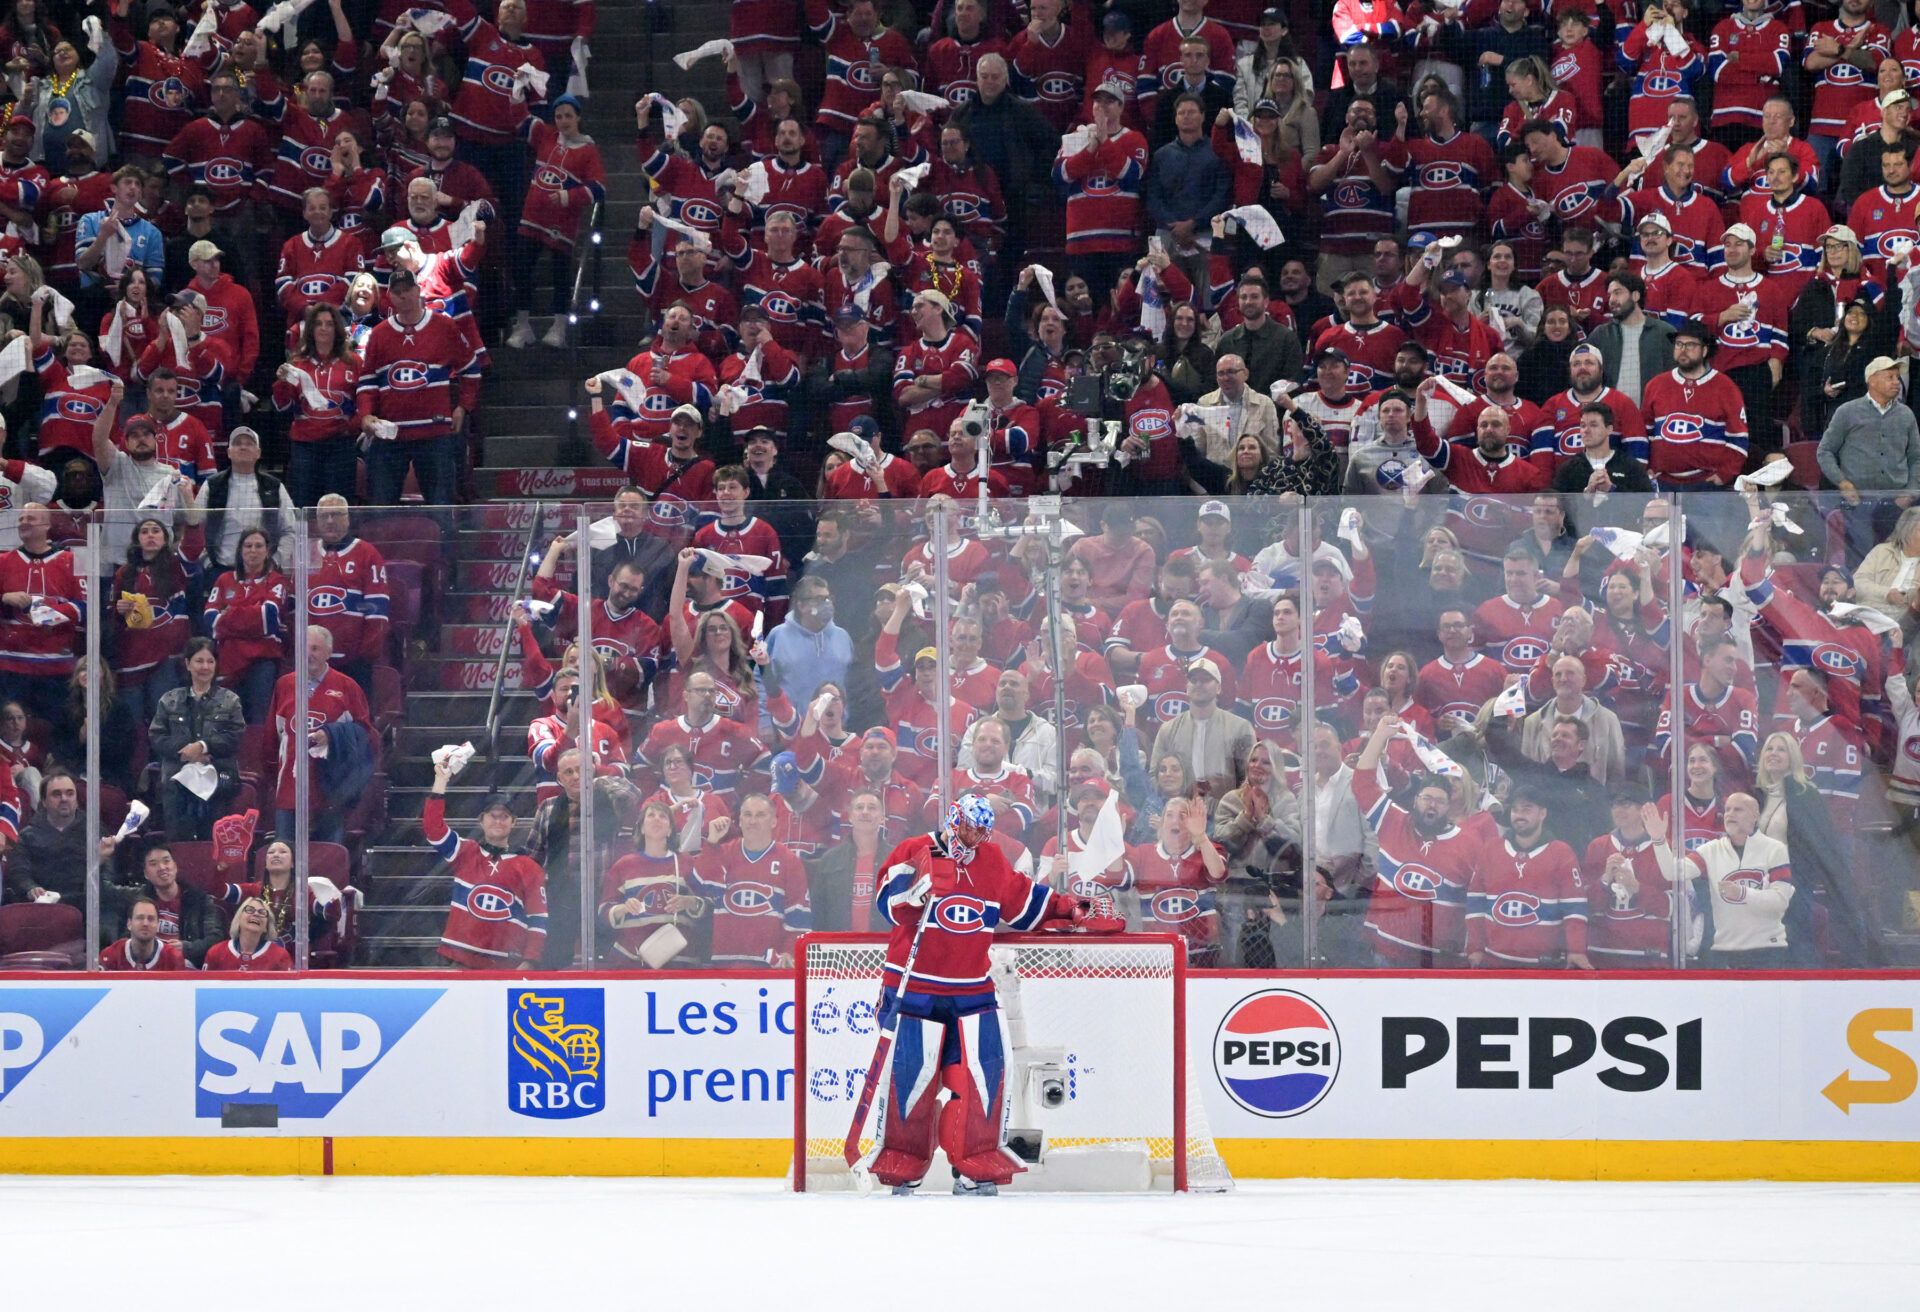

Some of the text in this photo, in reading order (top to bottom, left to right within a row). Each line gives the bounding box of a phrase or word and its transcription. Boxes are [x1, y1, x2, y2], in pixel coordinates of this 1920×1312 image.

[344, 560, 355, 574] C
[370, 564, 388, 584] 14
[598, 738, 610, 755] C
[720, 740, 731, 757] C
[770, 860, 781, 875] C
[644, 991, 738, 1036] Les
[198, 1009, 382, 1094] SAP
[1223, 1039, 1332, 1067] PEPSI
[1381, 1015, 1703, 1092] PEPSI
[518, 1080, 598, 1109] RBC
